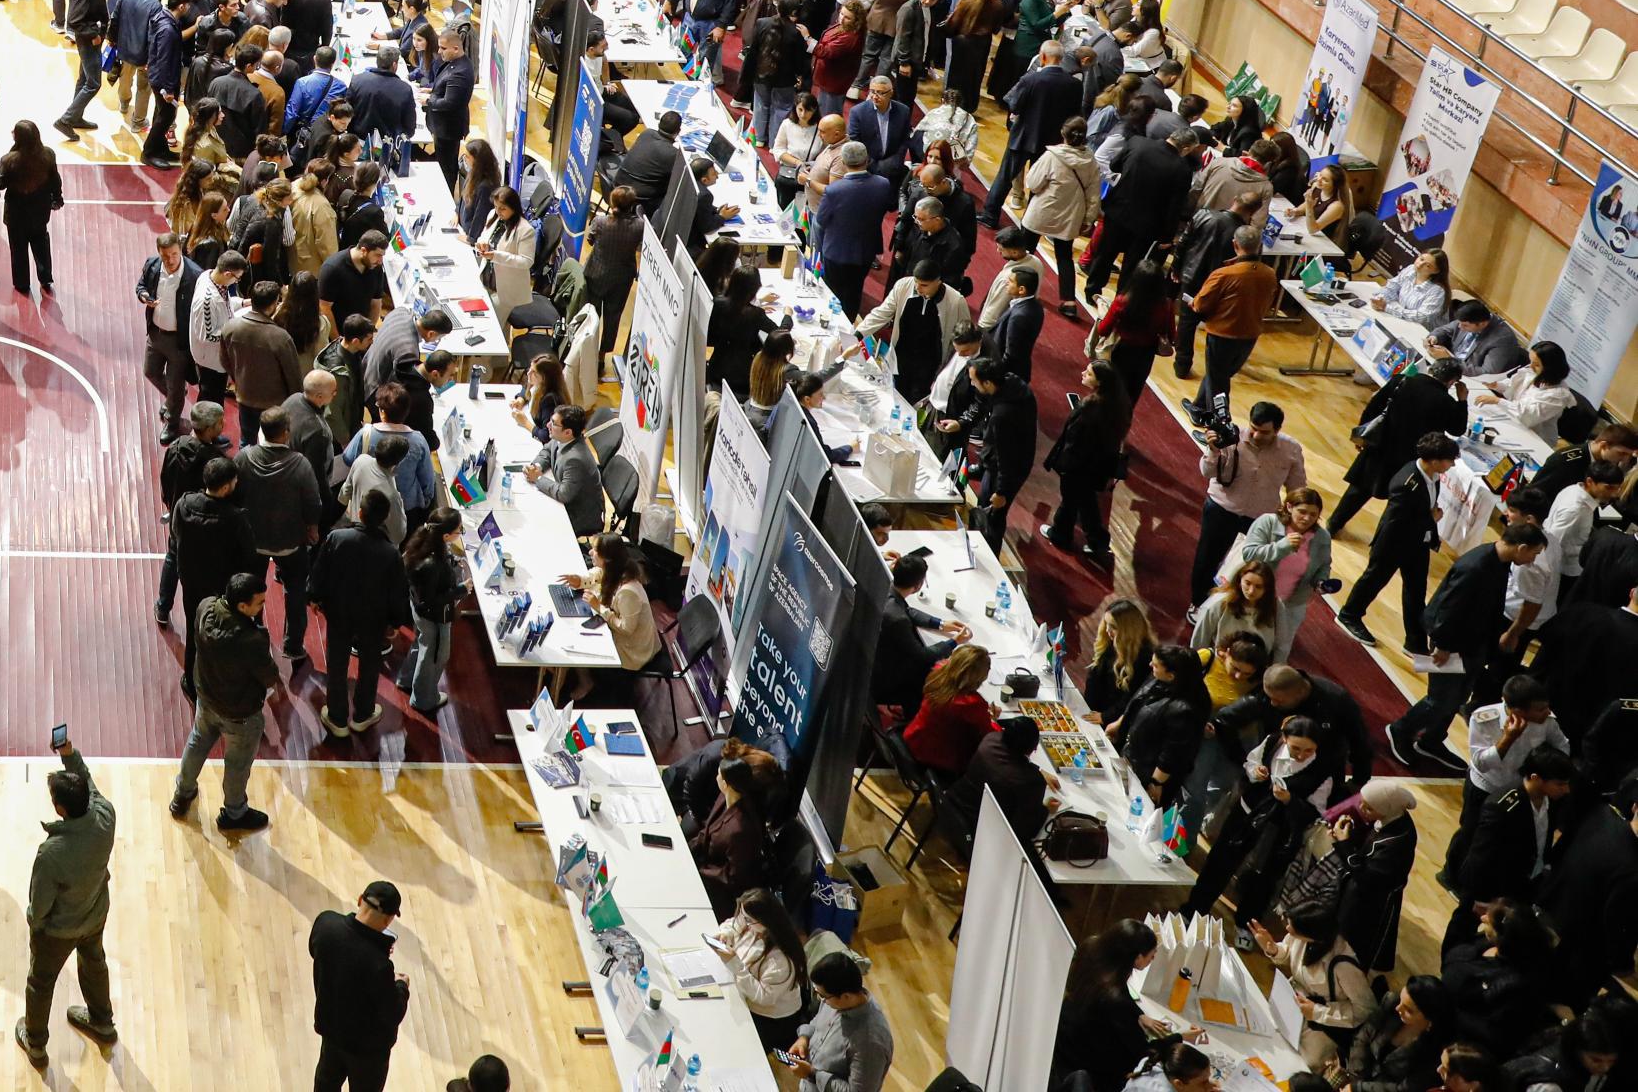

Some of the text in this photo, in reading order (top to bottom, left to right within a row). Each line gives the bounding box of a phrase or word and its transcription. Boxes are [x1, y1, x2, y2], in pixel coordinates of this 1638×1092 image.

[1429, 77, 1483, 117] Star HR Company
[641, 240, 679, 318] ZİREH MMC
[773, 563, 808, 611] SPACE AGENCY
[804, 548, 834, 592] azercosmos
[768, 581, 805, 632] OF AZERBAIJAN
[770, 573, 810, 629] OF THE REPUBLIC
[756, 622, 808, 701] Take your
[737, 694, 757, 728] the
[743, 674, 785, 733] beyond
[749, 645, 803, 737] talent
